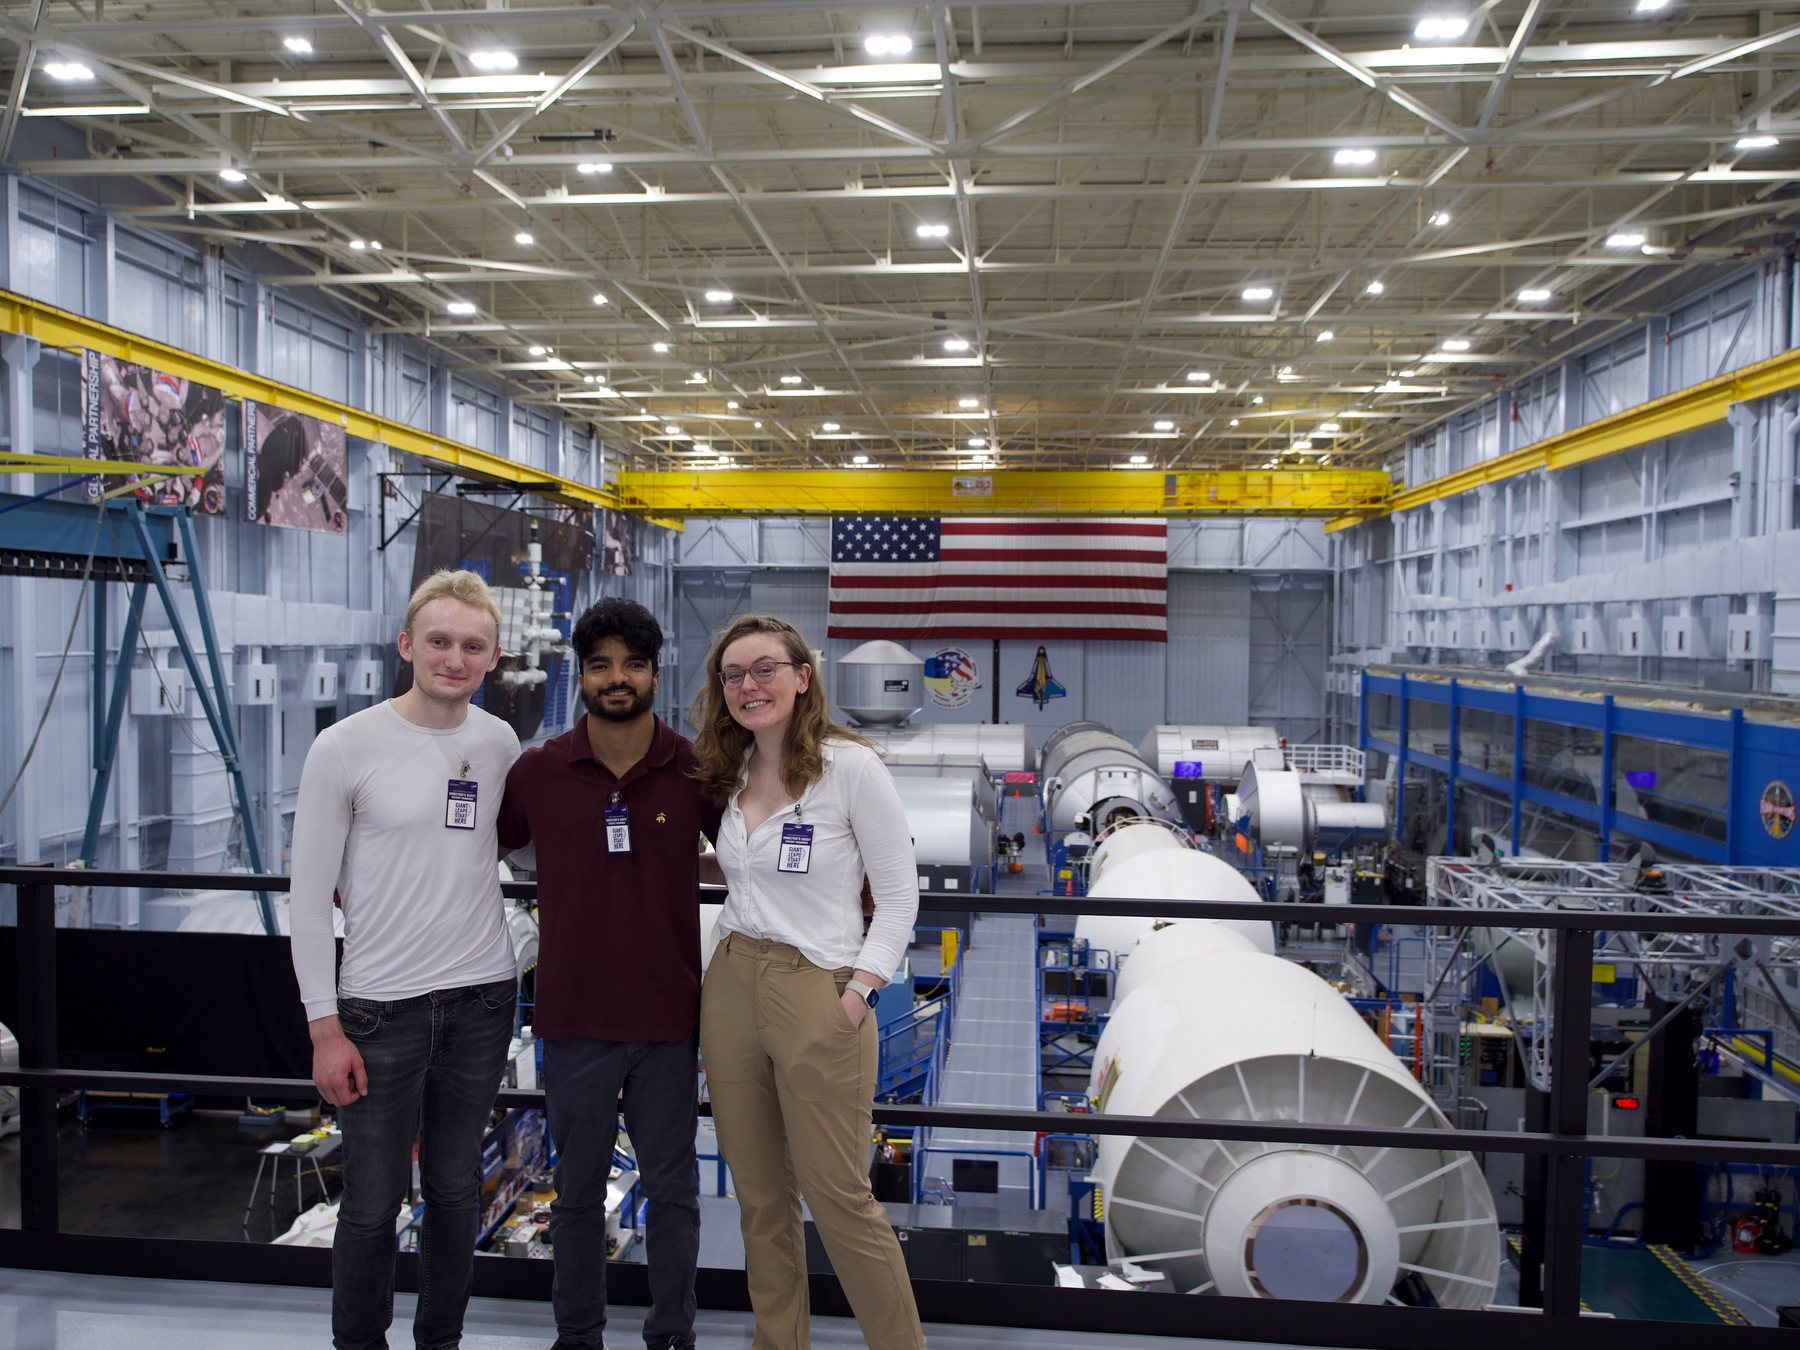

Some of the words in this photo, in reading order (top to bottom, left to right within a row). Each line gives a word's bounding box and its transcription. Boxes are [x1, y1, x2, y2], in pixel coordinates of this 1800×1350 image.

[88, 351, 99, 443] PARTNERSHIP
[247, 400, 256, 454] PARTNERS
[88, 446, 99, 497] GLAL
[247, 454, 256, 520] COMMERCIAL
